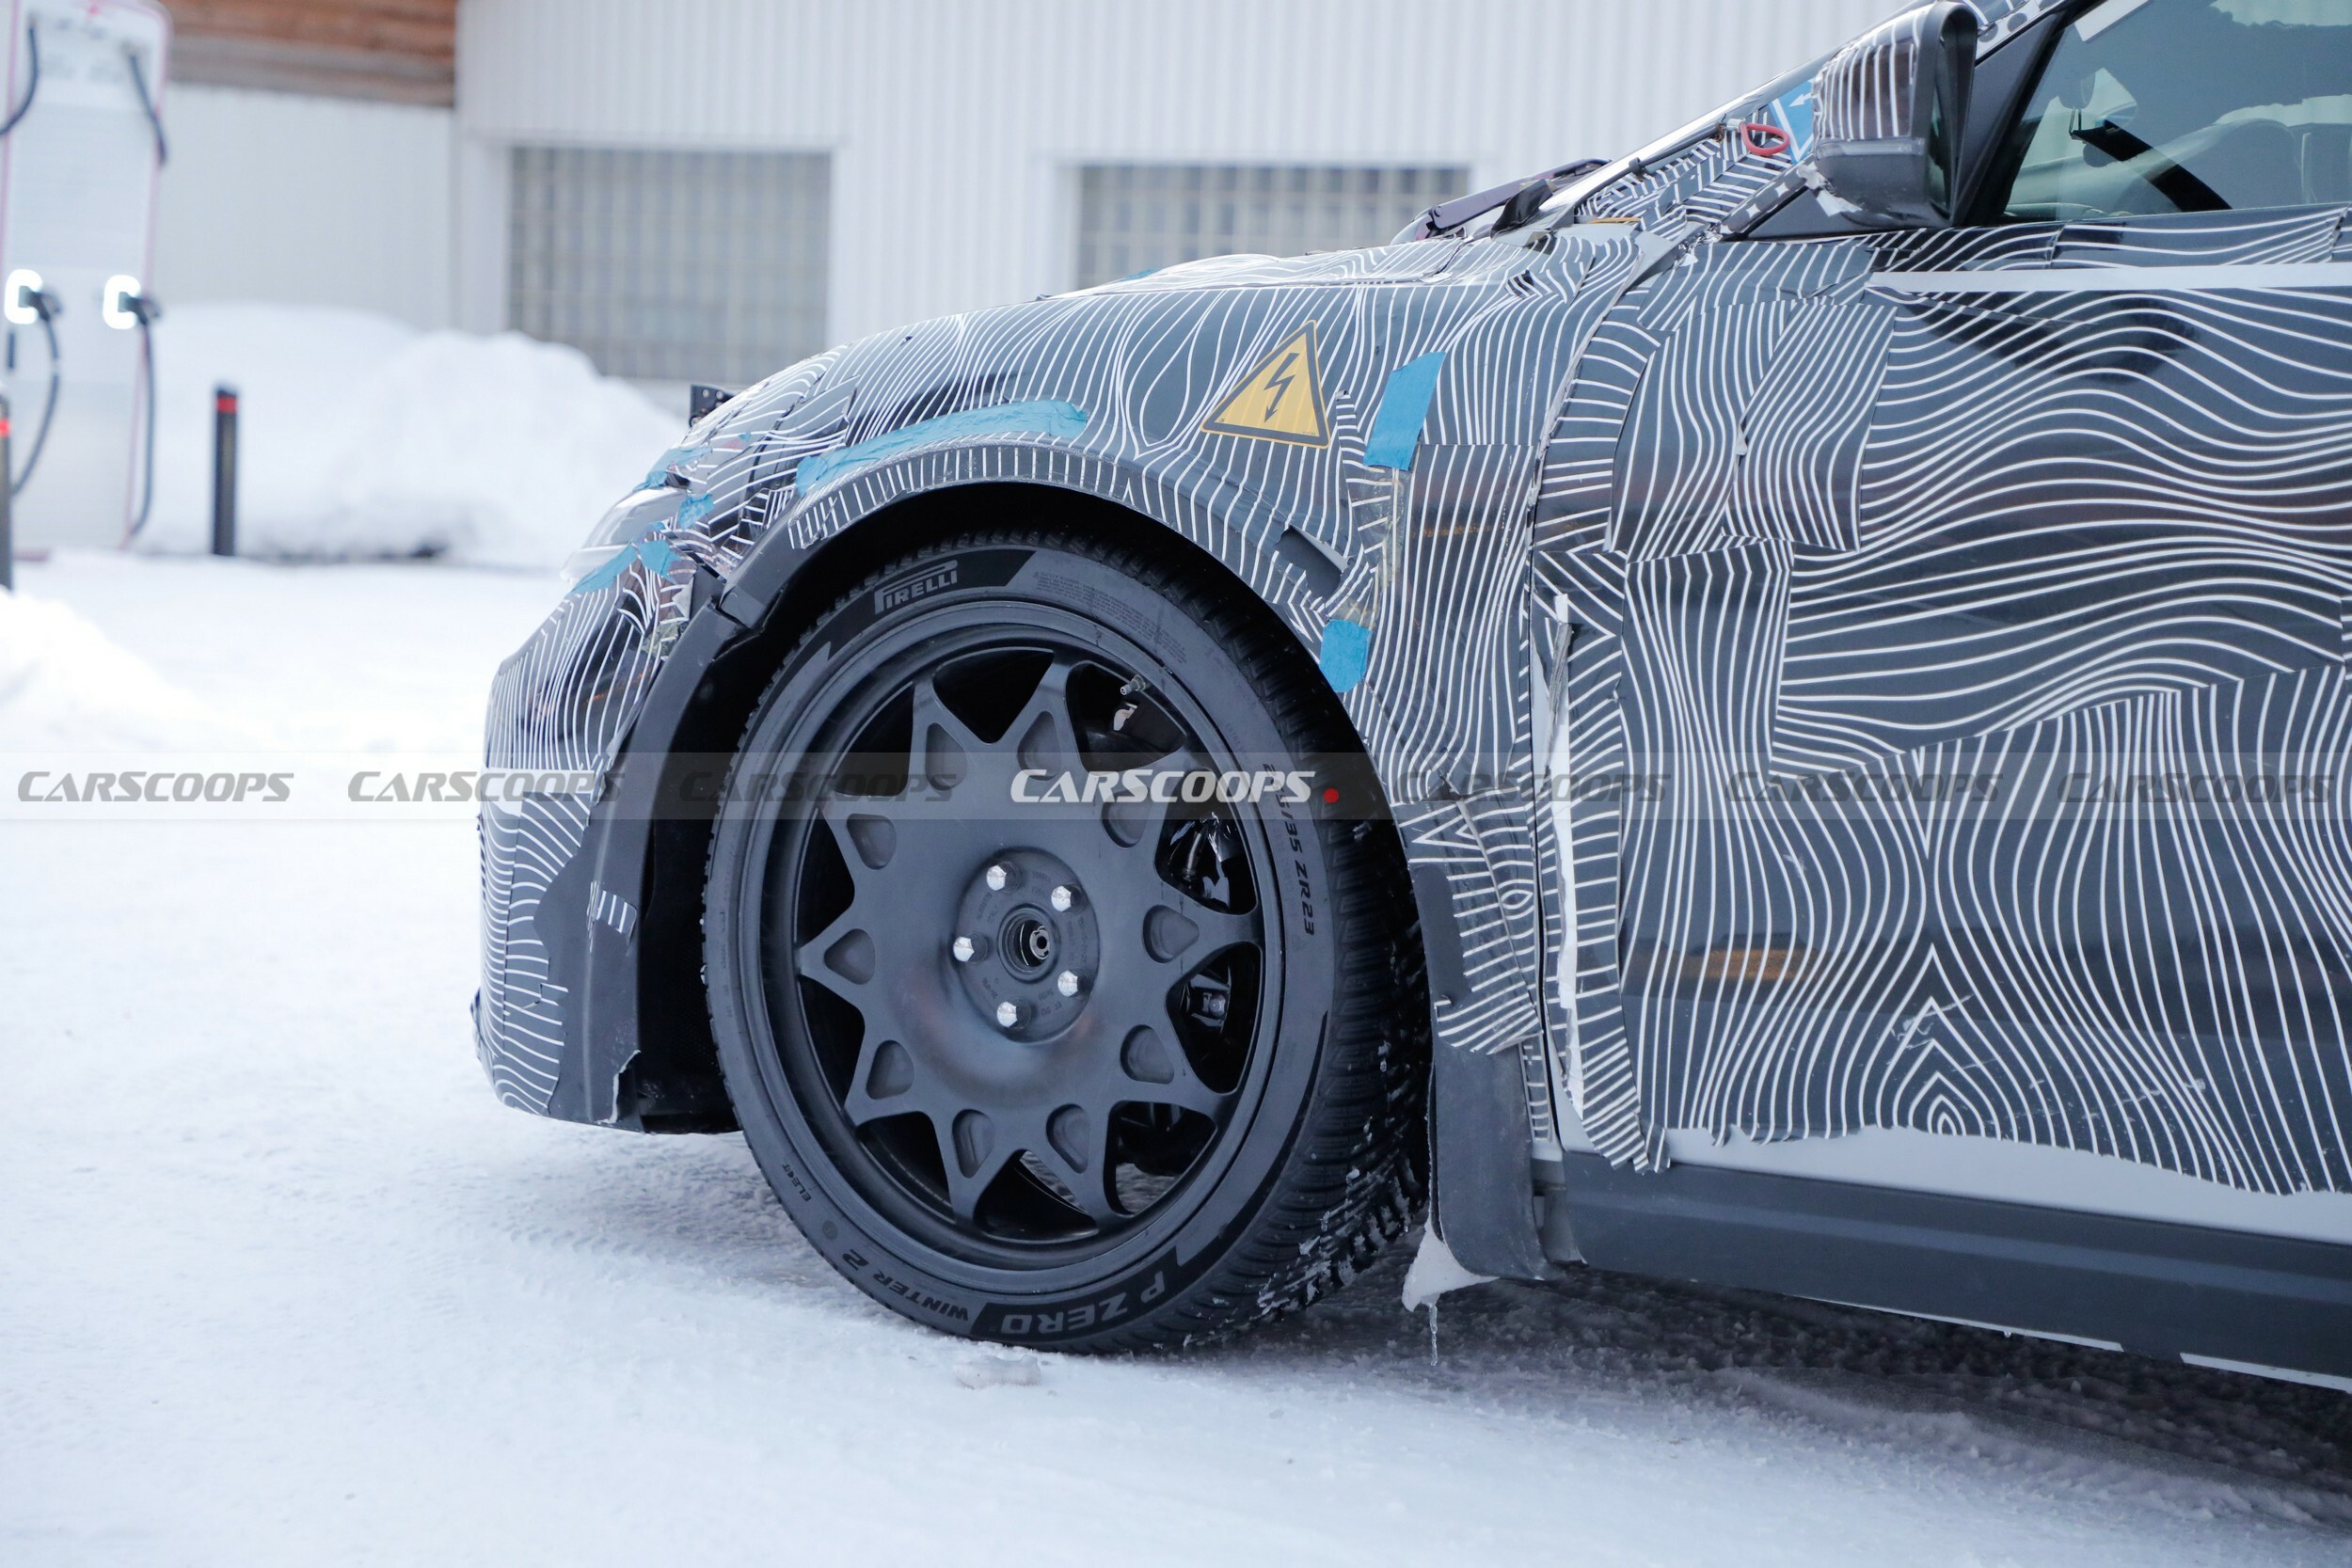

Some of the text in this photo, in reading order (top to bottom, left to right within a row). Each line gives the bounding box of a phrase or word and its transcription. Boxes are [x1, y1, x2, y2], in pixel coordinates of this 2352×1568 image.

[874, 560, 958, 614] PIRELLI
[1295, 860, 1315, 936] ZR23
[842, 1248, 969, 1321] WINTER 2
[1000, 1271, 1166, 1335] P ZERO
